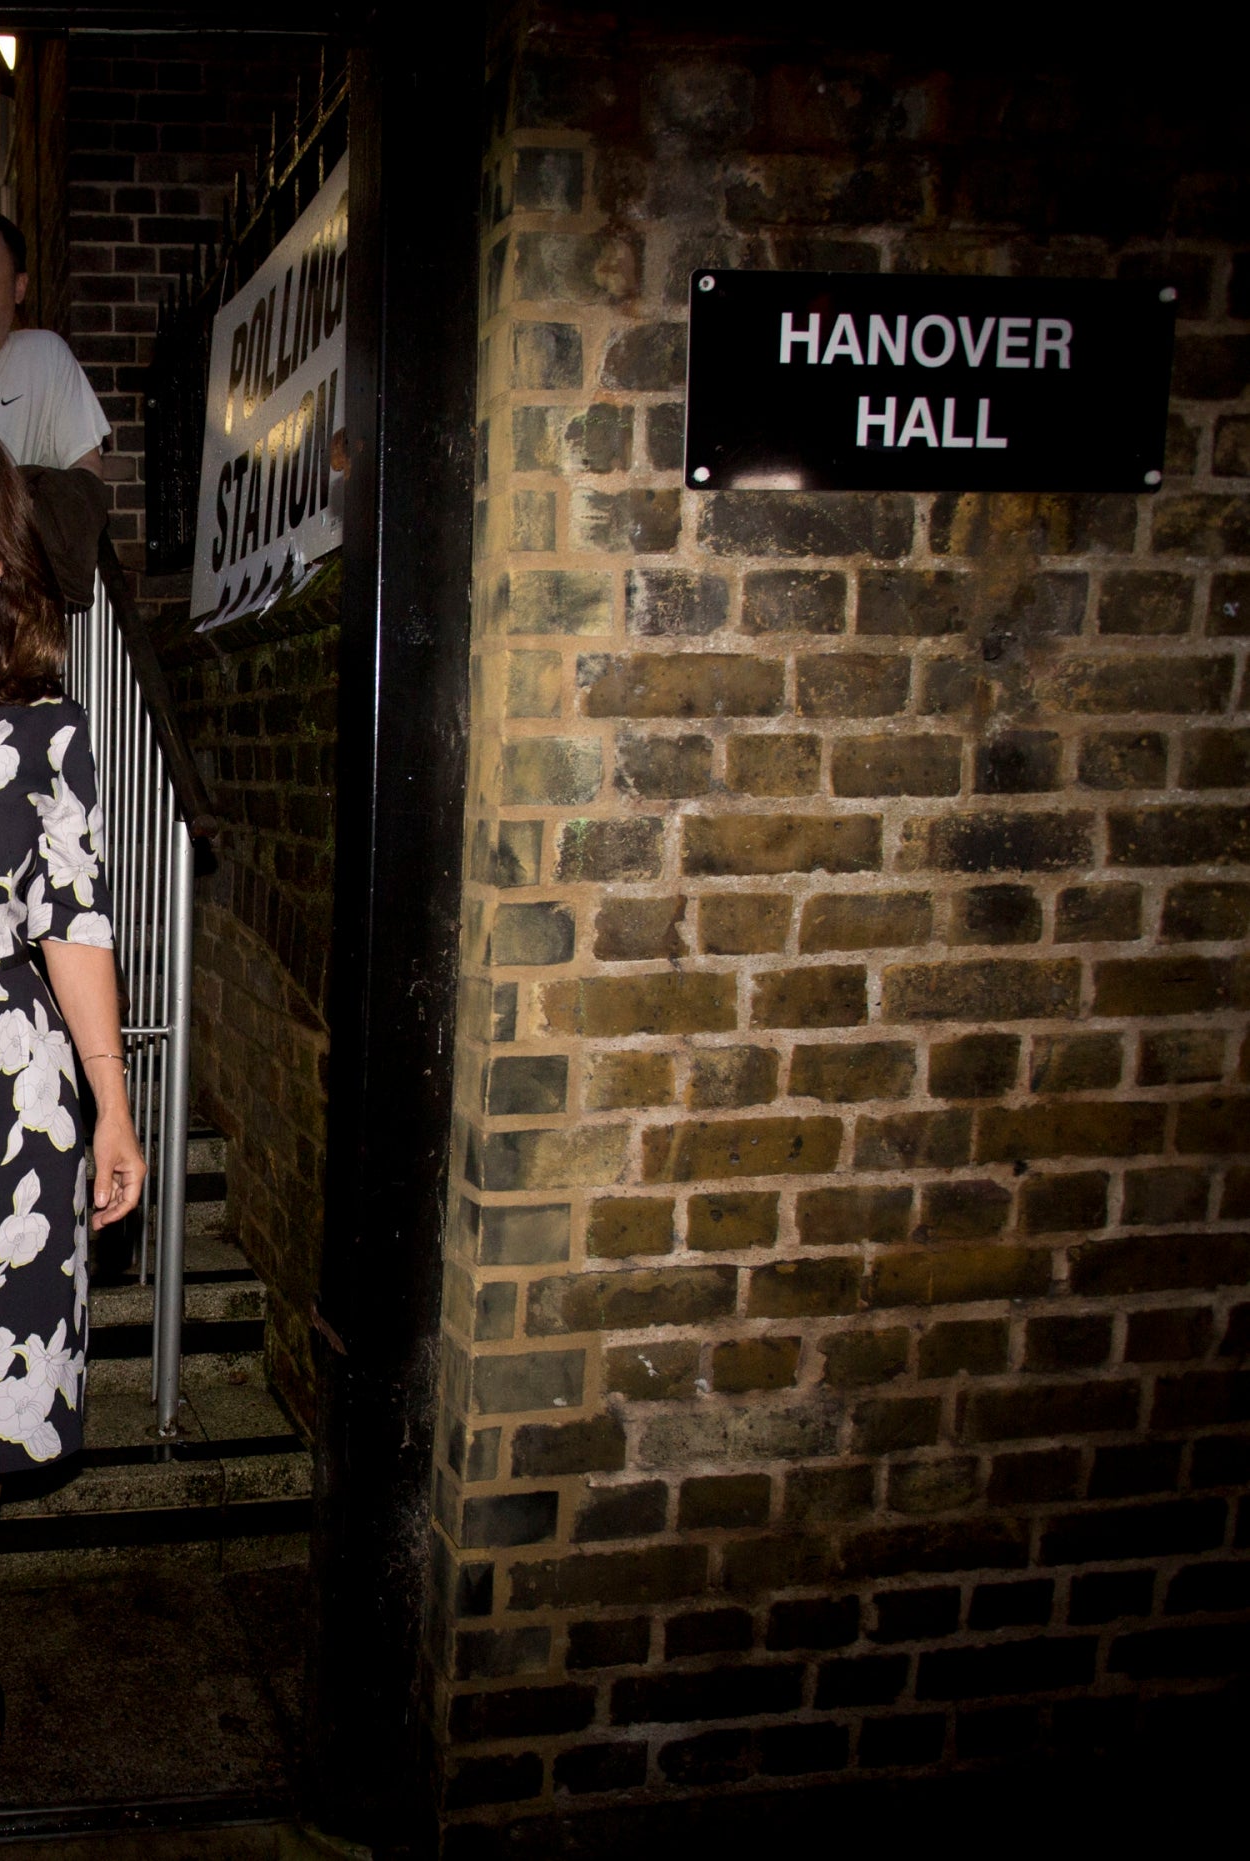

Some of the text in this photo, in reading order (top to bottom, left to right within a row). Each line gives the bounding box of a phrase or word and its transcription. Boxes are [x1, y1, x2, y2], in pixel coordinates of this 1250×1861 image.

[225, 188, 348, 434] POLLING
[778, 311, 1074, 369] HANOVER
[212, 364, 338, 574] STATION
[855, 395, 1008, 449] HALL
